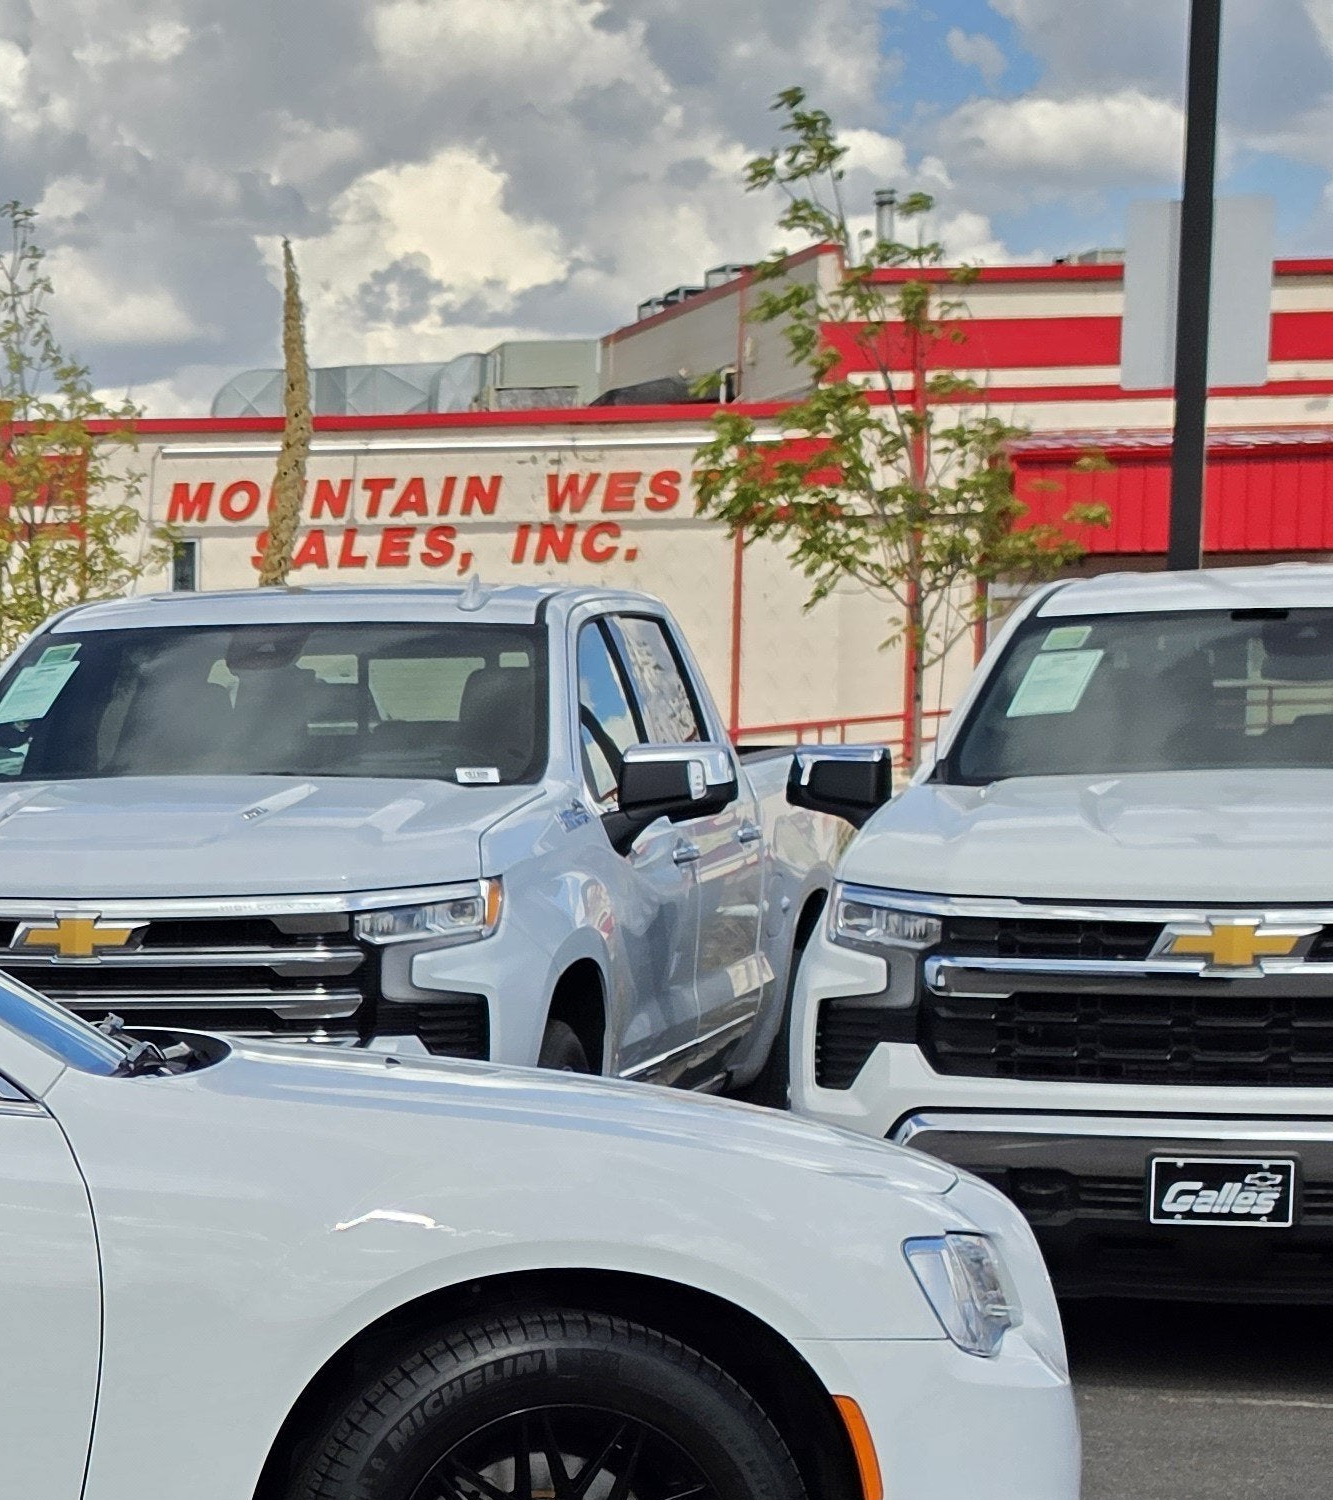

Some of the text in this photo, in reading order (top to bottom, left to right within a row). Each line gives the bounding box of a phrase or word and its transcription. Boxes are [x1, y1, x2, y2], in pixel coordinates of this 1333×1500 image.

[166, 470, 721, 523] MONTAIN WES
[511, 521, 639, 565] INC.
[1161, 1181, 1281, 1215] Galles
[386, 1350, 542, 1453] MICHELIN
